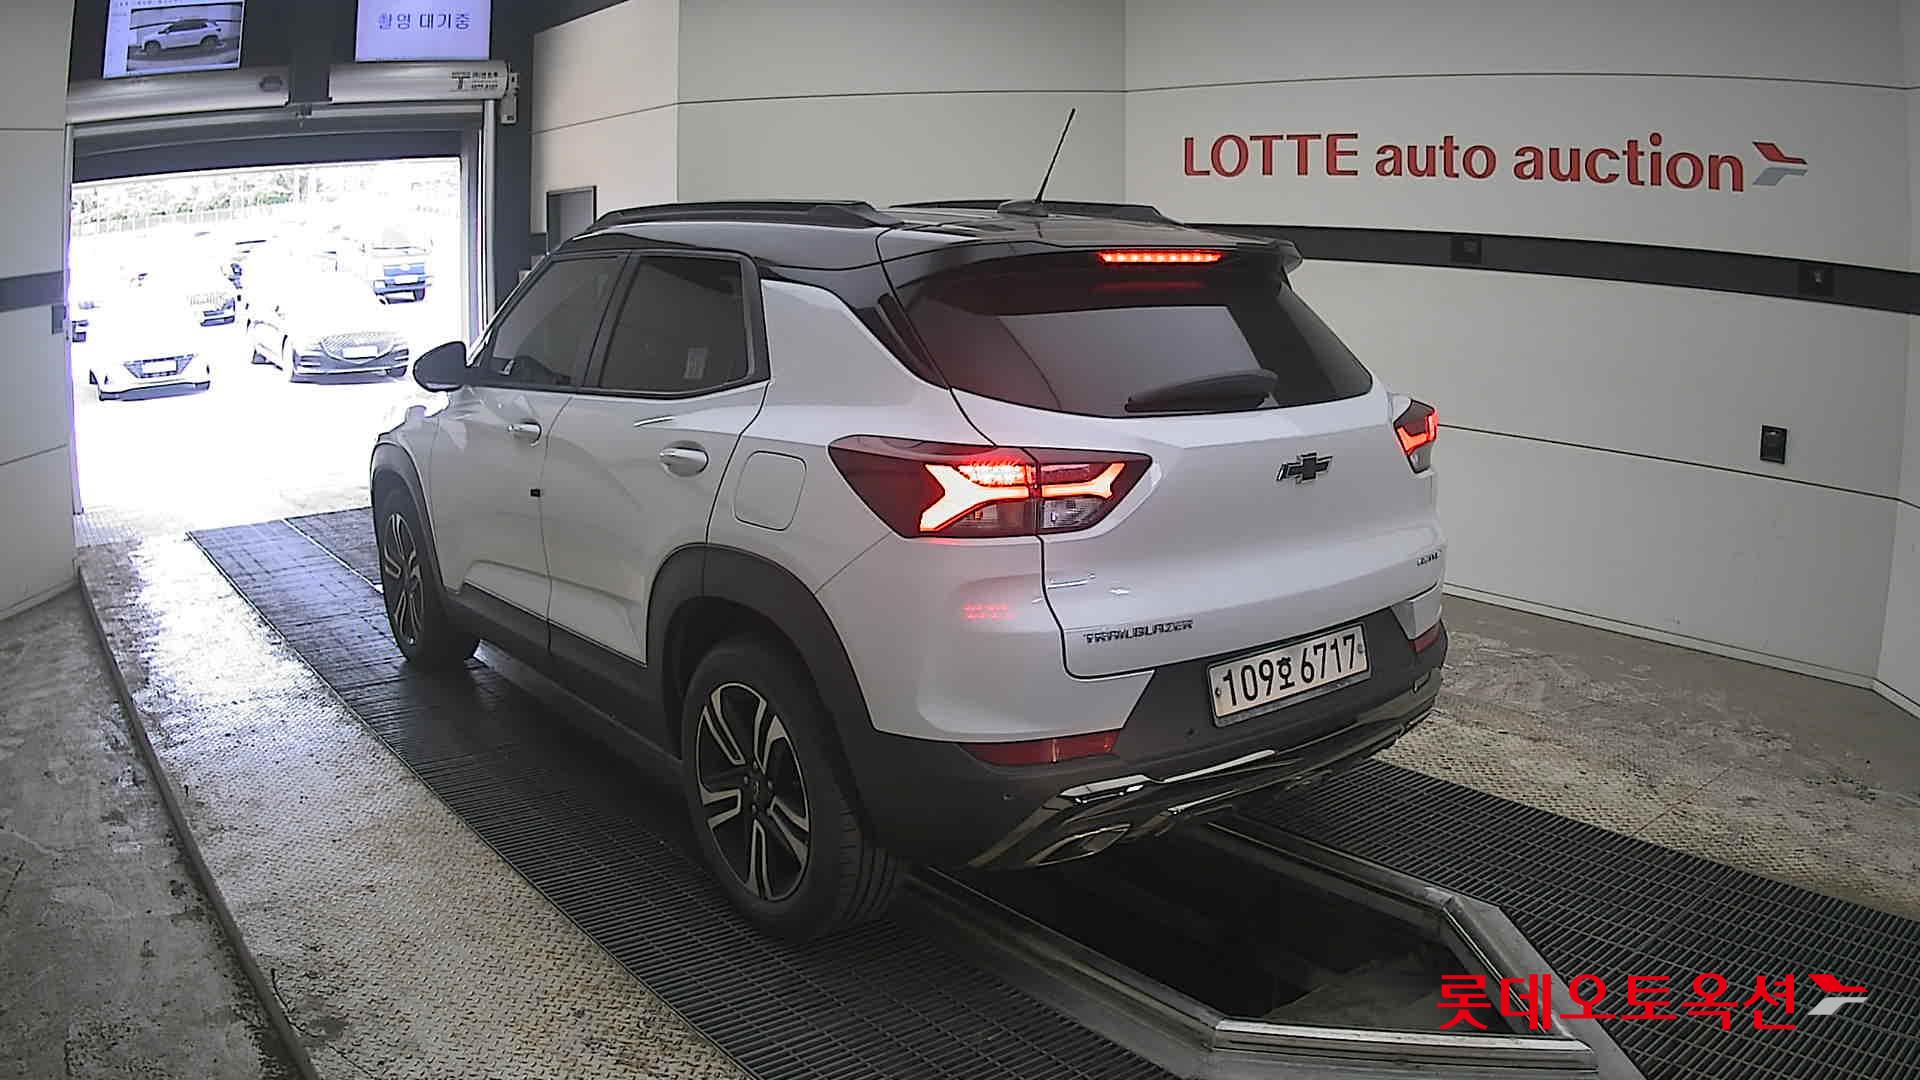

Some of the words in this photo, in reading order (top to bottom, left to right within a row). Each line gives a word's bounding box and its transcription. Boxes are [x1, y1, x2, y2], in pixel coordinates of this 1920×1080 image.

[419, 13, 472, 30] 대기중
[1183, 132, 1359, 177] LOTTE
[1375, 136, 1497, 179] auto
[1512, 132, 1745, 193] auction
[1084, 619, 1193, 643] TRAILBLAZER
[1300, 633, 1356, 684] 6717
